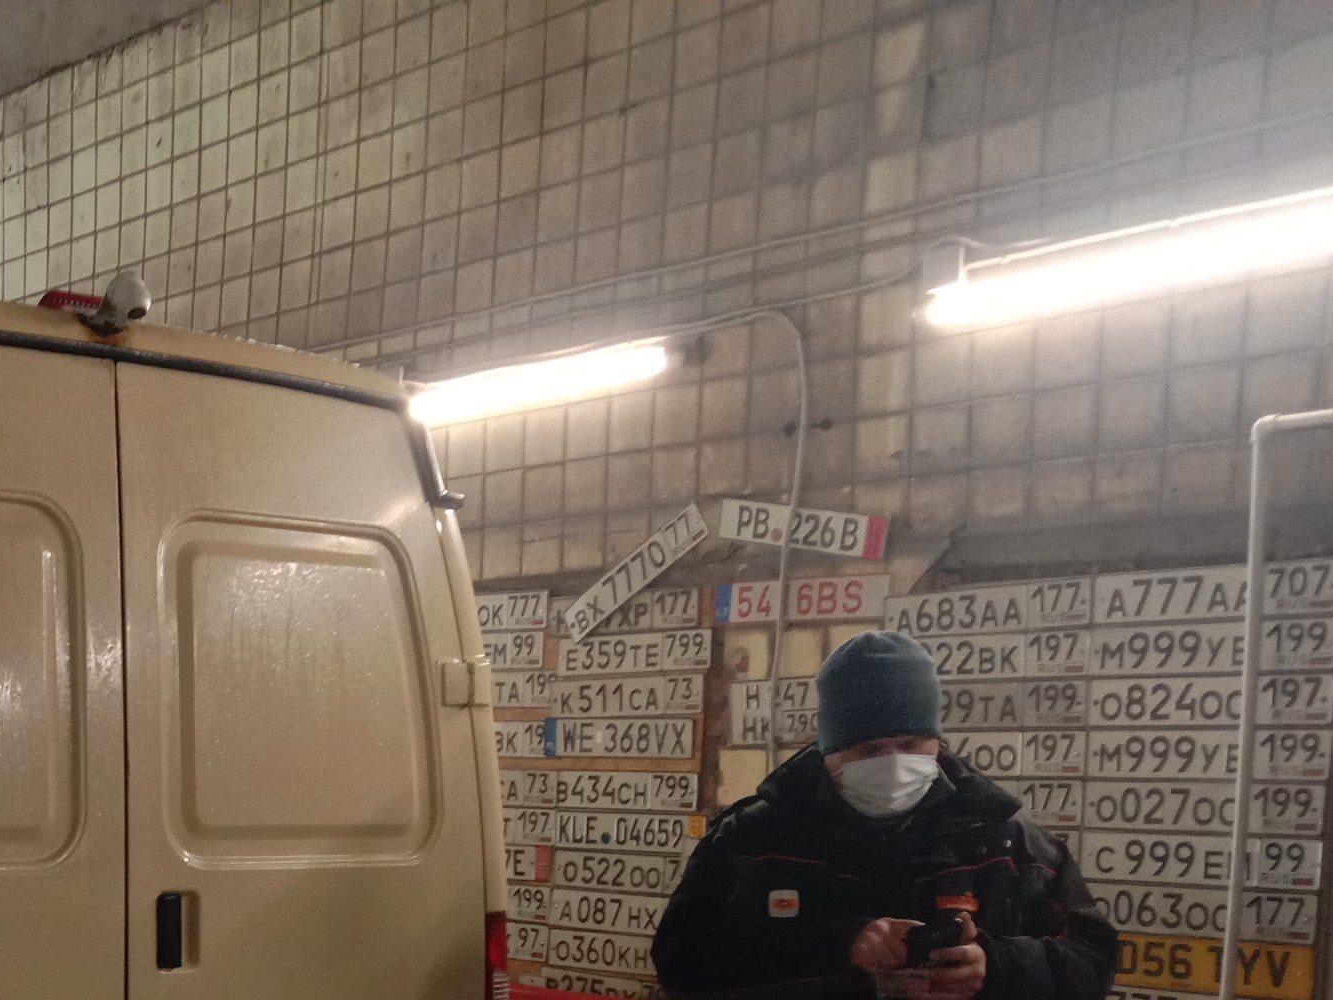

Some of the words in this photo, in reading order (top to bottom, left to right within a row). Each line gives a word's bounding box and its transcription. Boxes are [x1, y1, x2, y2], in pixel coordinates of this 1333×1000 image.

[736, 504, 770, 540] PB
[795, 579, 865, 616] 6BS
[1267, 565, 1331, 599] 707
[508, 594, 541, 617] 777
[655, 591, 692, 613] 177
[896, 593, 1022, 634] А683АА
[1029, 581, 1081, 614] 177
[513, 634, 535, 658] 99
[566, 640, 659, 672] Е359ТЕ
[666, 632, 705, 657] 799
[923, 640, 1019, 676] 22ВК
[1028, 631, 1079, 664] 197
[1266, 621, 1327, 654] 199
[560, 682, 660, 715] К511СА
[667, 678, 693, 700] 73
[1028, 682, 1080, 711] 199
[1262, 676, 1322, 709] 197
[562, 722, 595, 753] WE
[603, 721, 686, 756] 368VX
[939, 736, 1017, 772] 4ОО
[1026, 733, 1077, 764] 197
[1260, 731, 1316, 765] 199
[527, 772, 549, 795] 73
[556, 774, 649, 806] В434СН
[652, 774, 691, 799] 799
[1022, 781, 1072, 811] 177
[1253, 786, 1313, 818] 199
[517, 810, 550, 834] 197
[559, 814, 598, 845] KLE
[615, 816, 684, 848] 04659
[562, 856, 661, 889] О522ОО
[1264, 841, 1306, 873] 99
[513, 888, 546, 911] 199
[558, 895, 658, 930] А087НХ
[1246, 895, 1306, 928] 177
[519, 927, 540, 949] 97
[555, 934, 649, 968] О360КН
